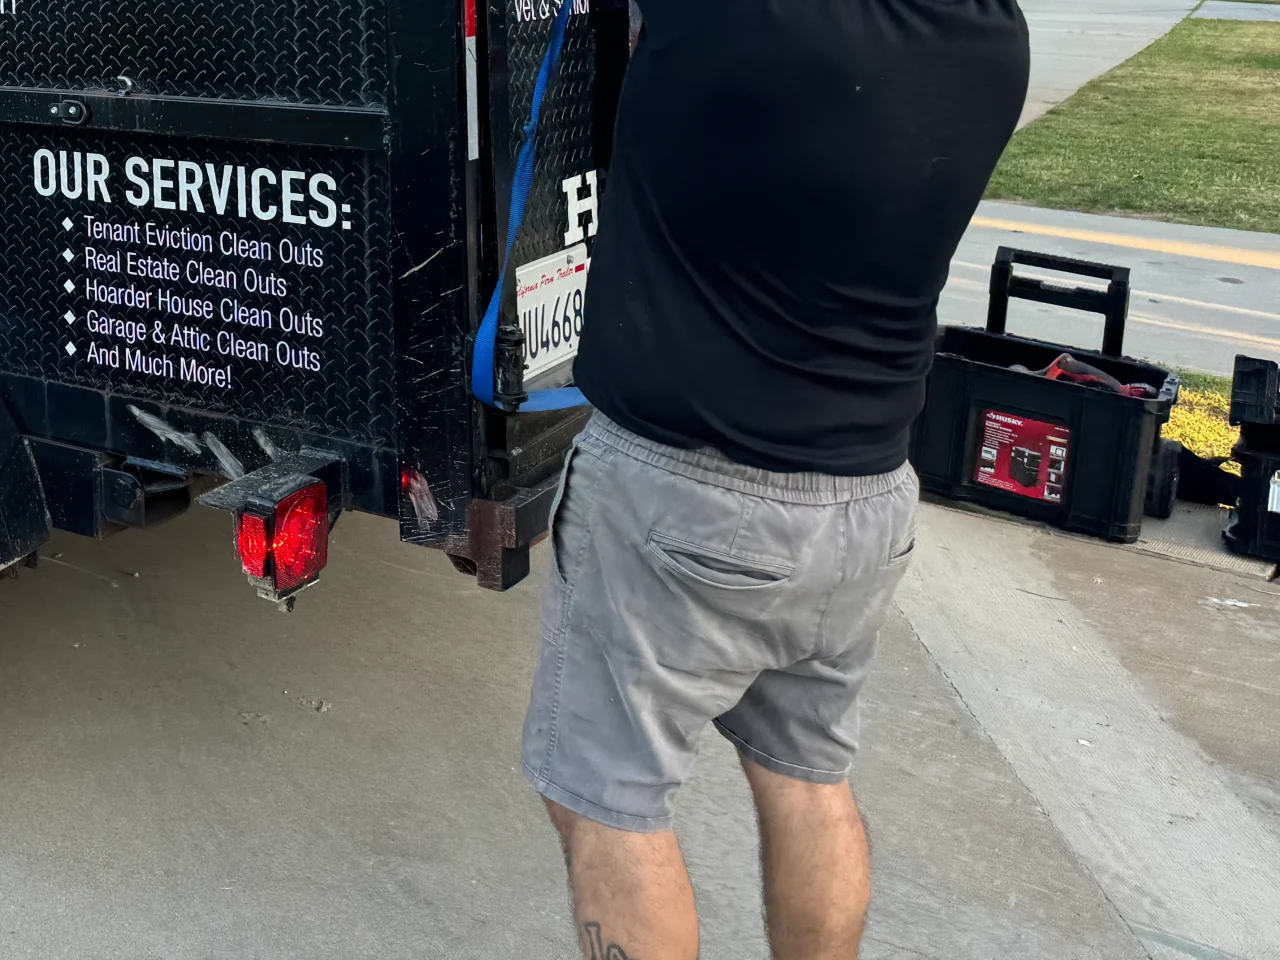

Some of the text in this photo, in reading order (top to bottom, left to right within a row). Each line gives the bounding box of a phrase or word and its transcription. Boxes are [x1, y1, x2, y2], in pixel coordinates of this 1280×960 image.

[33, 148, 352, 231] OUR SERVICES:
[84, 214, 324, 268] Tenant Eviction Clean Outs
[85, 247, 287, 298] Real Estate Clean Outs
[85, 278, 324, 338] Hoarder House Clean Outs
[86, 310, 321, 372] Garage & Attic Clean Outs
[86, 341, 232, 389] And Much More!
